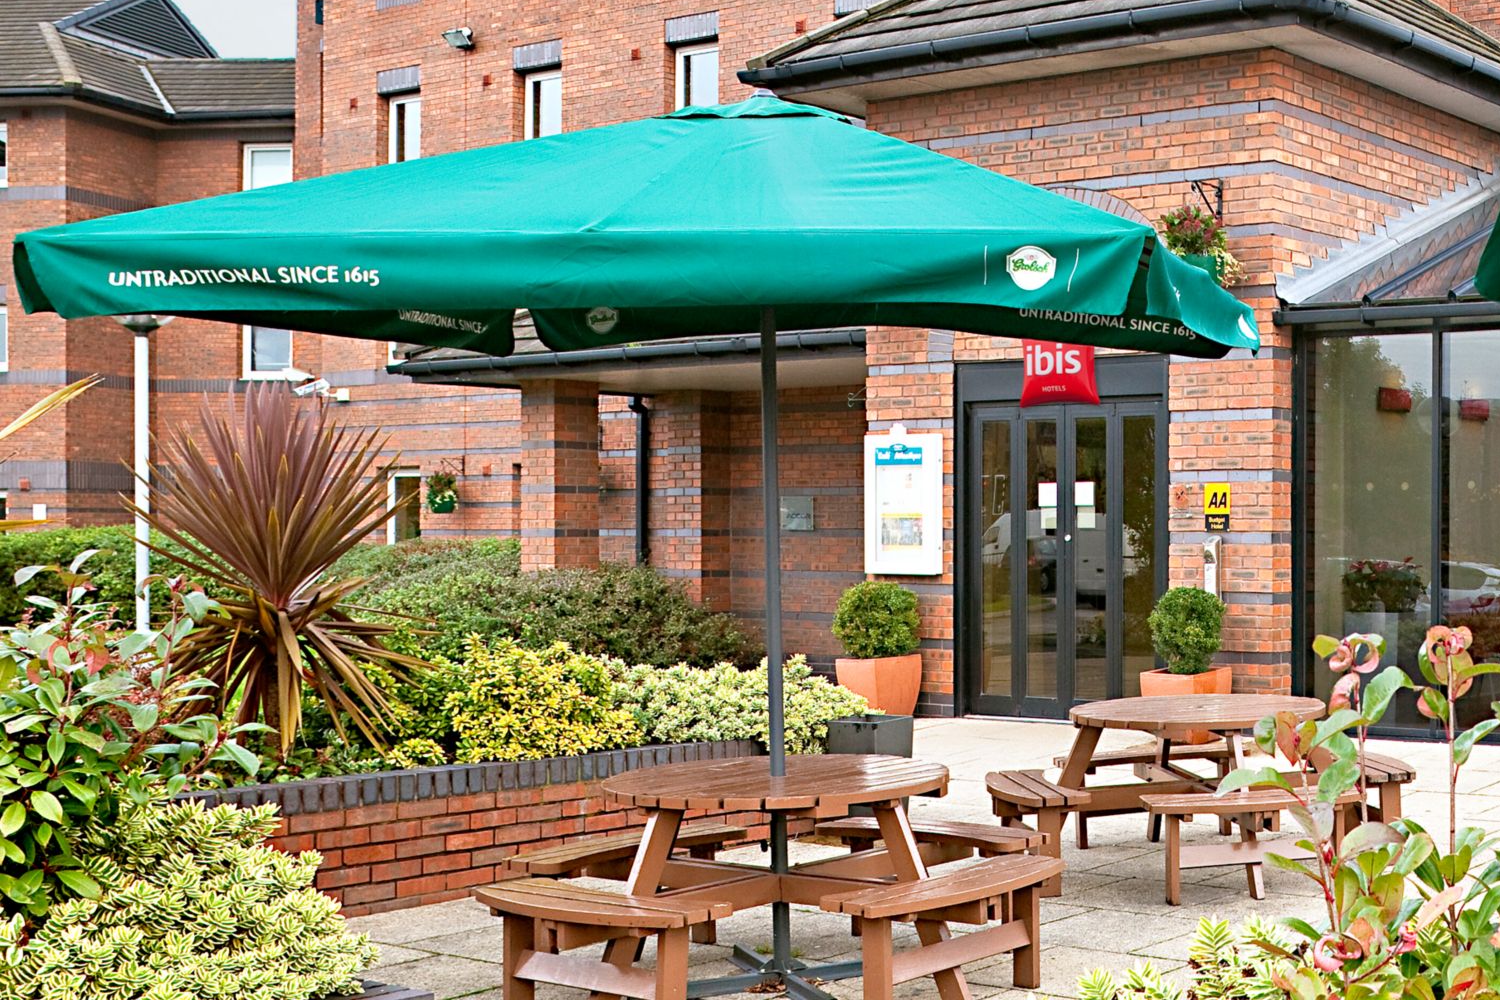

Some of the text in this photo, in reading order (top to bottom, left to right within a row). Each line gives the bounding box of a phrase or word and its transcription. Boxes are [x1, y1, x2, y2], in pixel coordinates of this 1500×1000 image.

[108, 265, 380, 288] UNTRADITIONAL SINCE 1615
[398, 308, 459, 330] UNTRADITIONAL
[1019, 308, 1197, 340] UNTRADITIONAL SINCE 1615
[1026, 343, 1082, 377] ibis
[1041, 384, 1067, 393] HOTELS
[1208, 491, 1227, 508] AA
